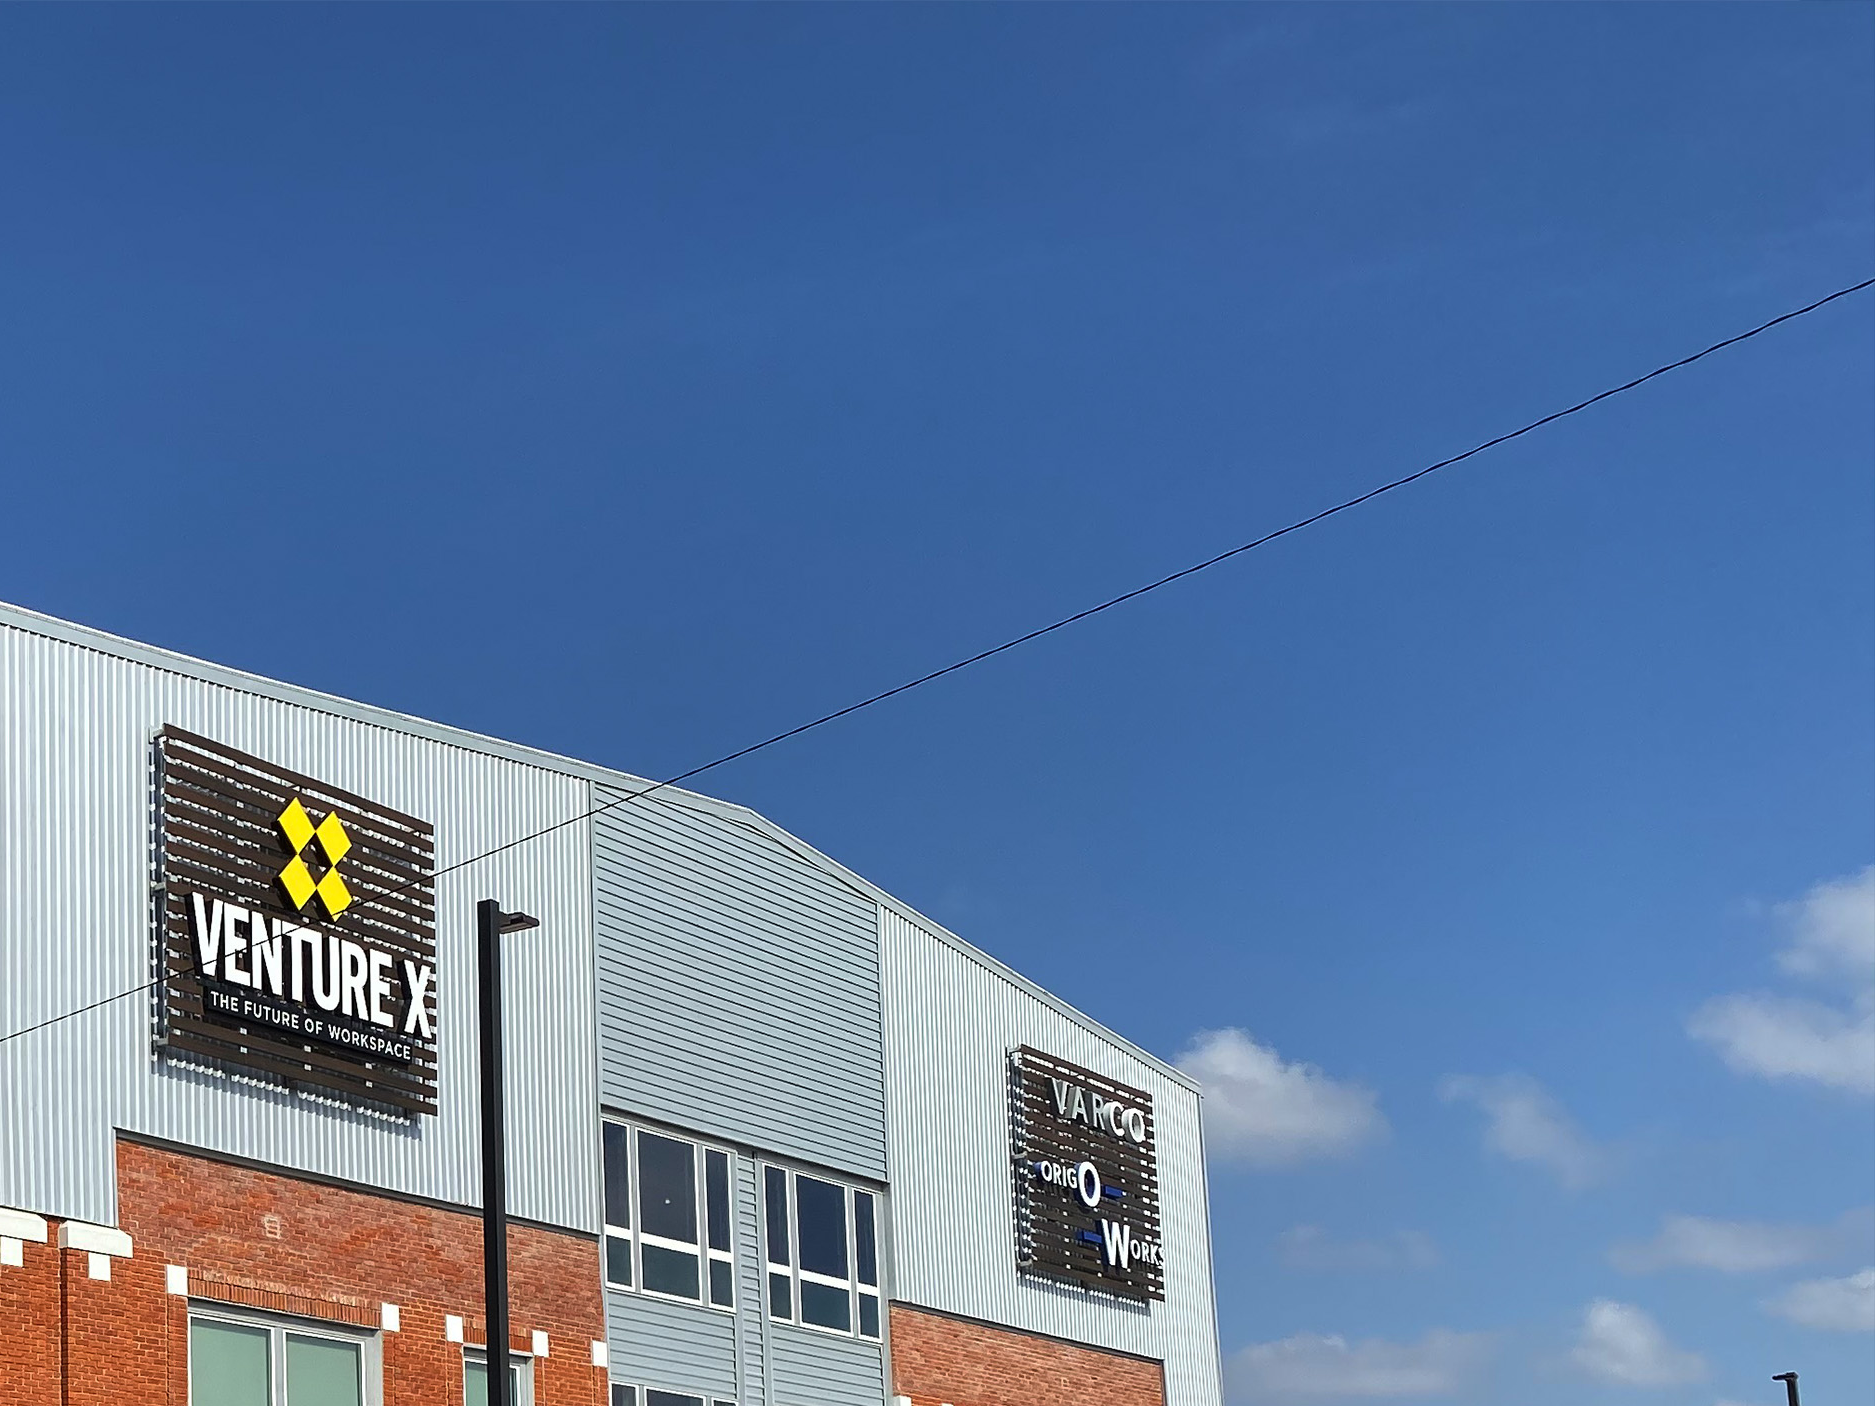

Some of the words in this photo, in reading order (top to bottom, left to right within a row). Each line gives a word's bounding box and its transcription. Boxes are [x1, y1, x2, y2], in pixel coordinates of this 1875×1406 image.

[191, 891, 395, 1028] VENTURE
[404, 959, 433, 1039] X
[210, 990, 239, 1013] THE
[244, 1001, 300, 1030] FUTURE
[304, 1017, 324, 1035] OF
[327, 1023, 412, 1060] WORKSPACE
[1049, 1077, 1146, 1144] VARCO
[1040, 1160, 1101, 1208] ORIGO
[1101, 1218, 1165, 1269] WORKS
